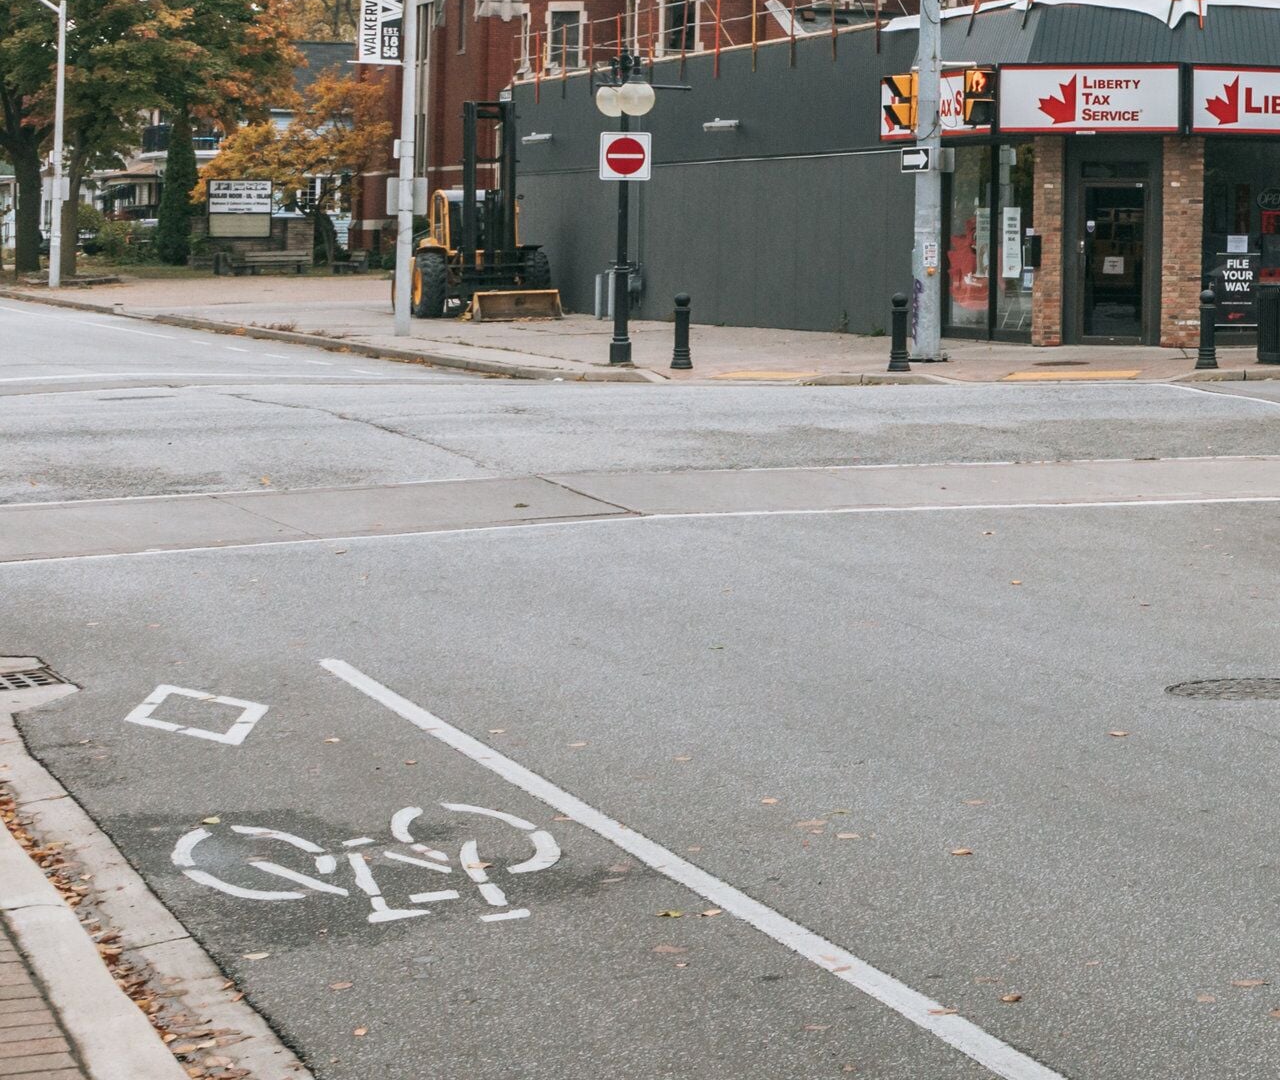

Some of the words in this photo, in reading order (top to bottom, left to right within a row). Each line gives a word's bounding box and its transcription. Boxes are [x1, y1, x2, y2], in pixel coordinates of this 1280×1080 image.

[383, 27, 399, 35] EST.
[384, 36, 399, 47] 18
[383, 46, 399, 57] 58
[1083, 76, 1141, 89] LIBERTY
[1082, 93, 1110, 105] TAX
[1227, 259, 1249, 269] FILE
[1222, 270, 1253, 280] YOUR
[1224, 282, 1250, 292] WAY.
